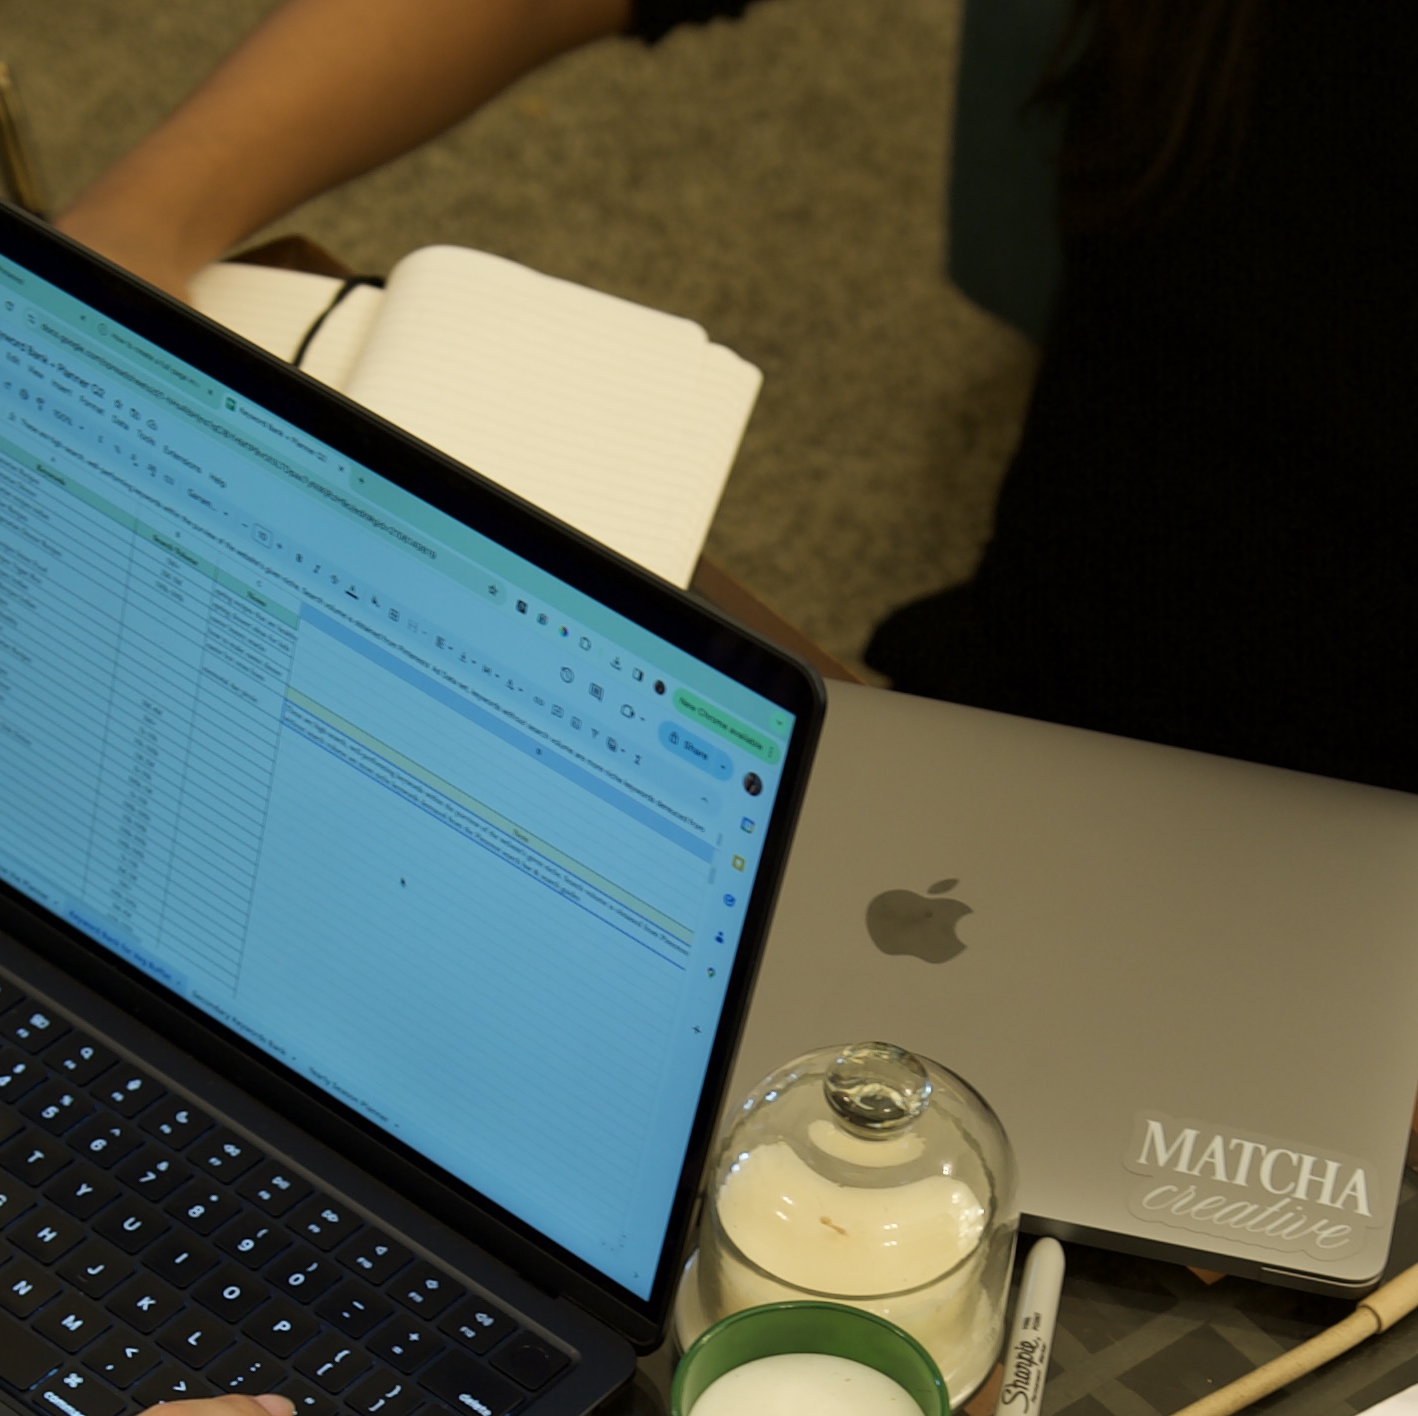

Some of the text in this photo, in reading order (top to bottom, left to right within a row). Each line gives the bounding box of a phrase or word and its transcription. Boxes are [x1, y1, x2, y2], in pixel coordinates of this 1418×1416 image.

[42, 1106, 59, 1119] 5
[90, 1138, 107, 1151] 6
[27, 1150, 44, 1163] T
[1136, 1119, 1373, 1218] MATCHA
[140, 1171, 156, 1182] 7
[76, 1183, 93, 1196] Y
[188, 1205, 205, 1218] 8
[1141, 1184, 1353, 1249] creative
[123, 1217, 142, 1231] U
[37, 1227, 57, 1242] H
[237, 1238, 255, 1252] 9
[87, 1264, 105, 1275] J
[12, 1280, 33, 1296] N
[223, 1286, 241, 1300] O
[136, 1296, 156, 1311] K
[61, 1314, 83, 1331] M
[272, 1320, 292, 1331] P
[187, 1331, 202, 1346] L
[1002, 1337, 1040, 1415] Sharpie
